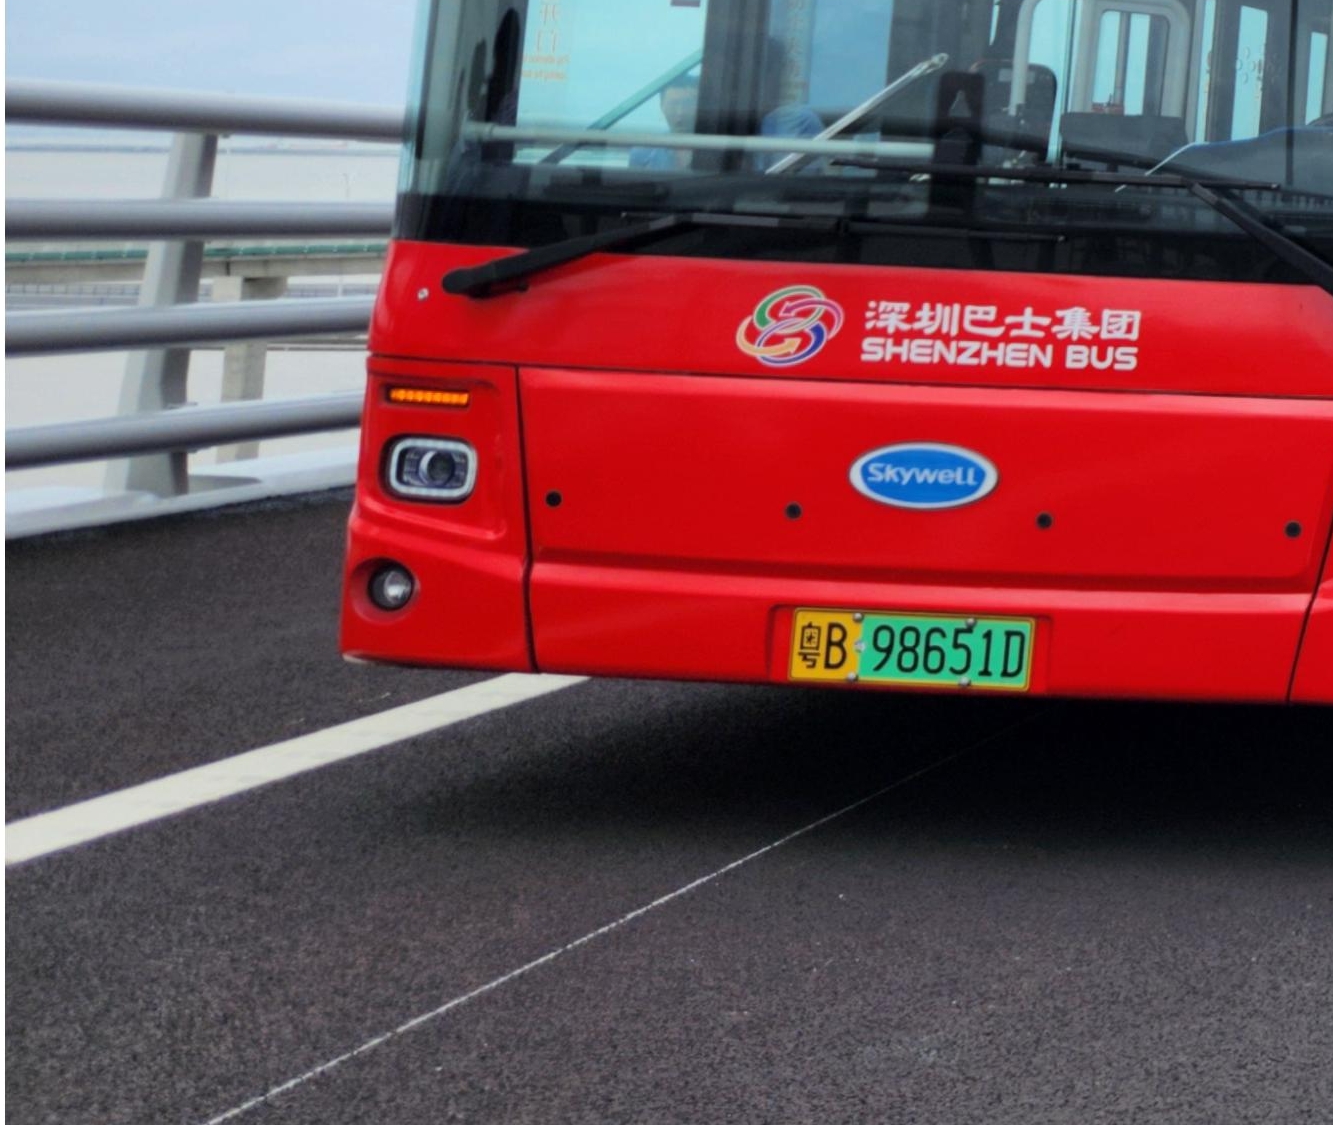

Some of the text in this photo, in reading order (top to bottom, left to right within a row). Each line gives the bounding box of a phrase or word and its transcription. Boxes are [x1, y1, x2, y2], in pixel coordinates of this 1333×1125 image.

[864, 300, 1142, 342] 深圳巴士集团
[860, 336, 1139, 371] SHENZHEN BUS
[866, 461, 978, 486] Skywell
